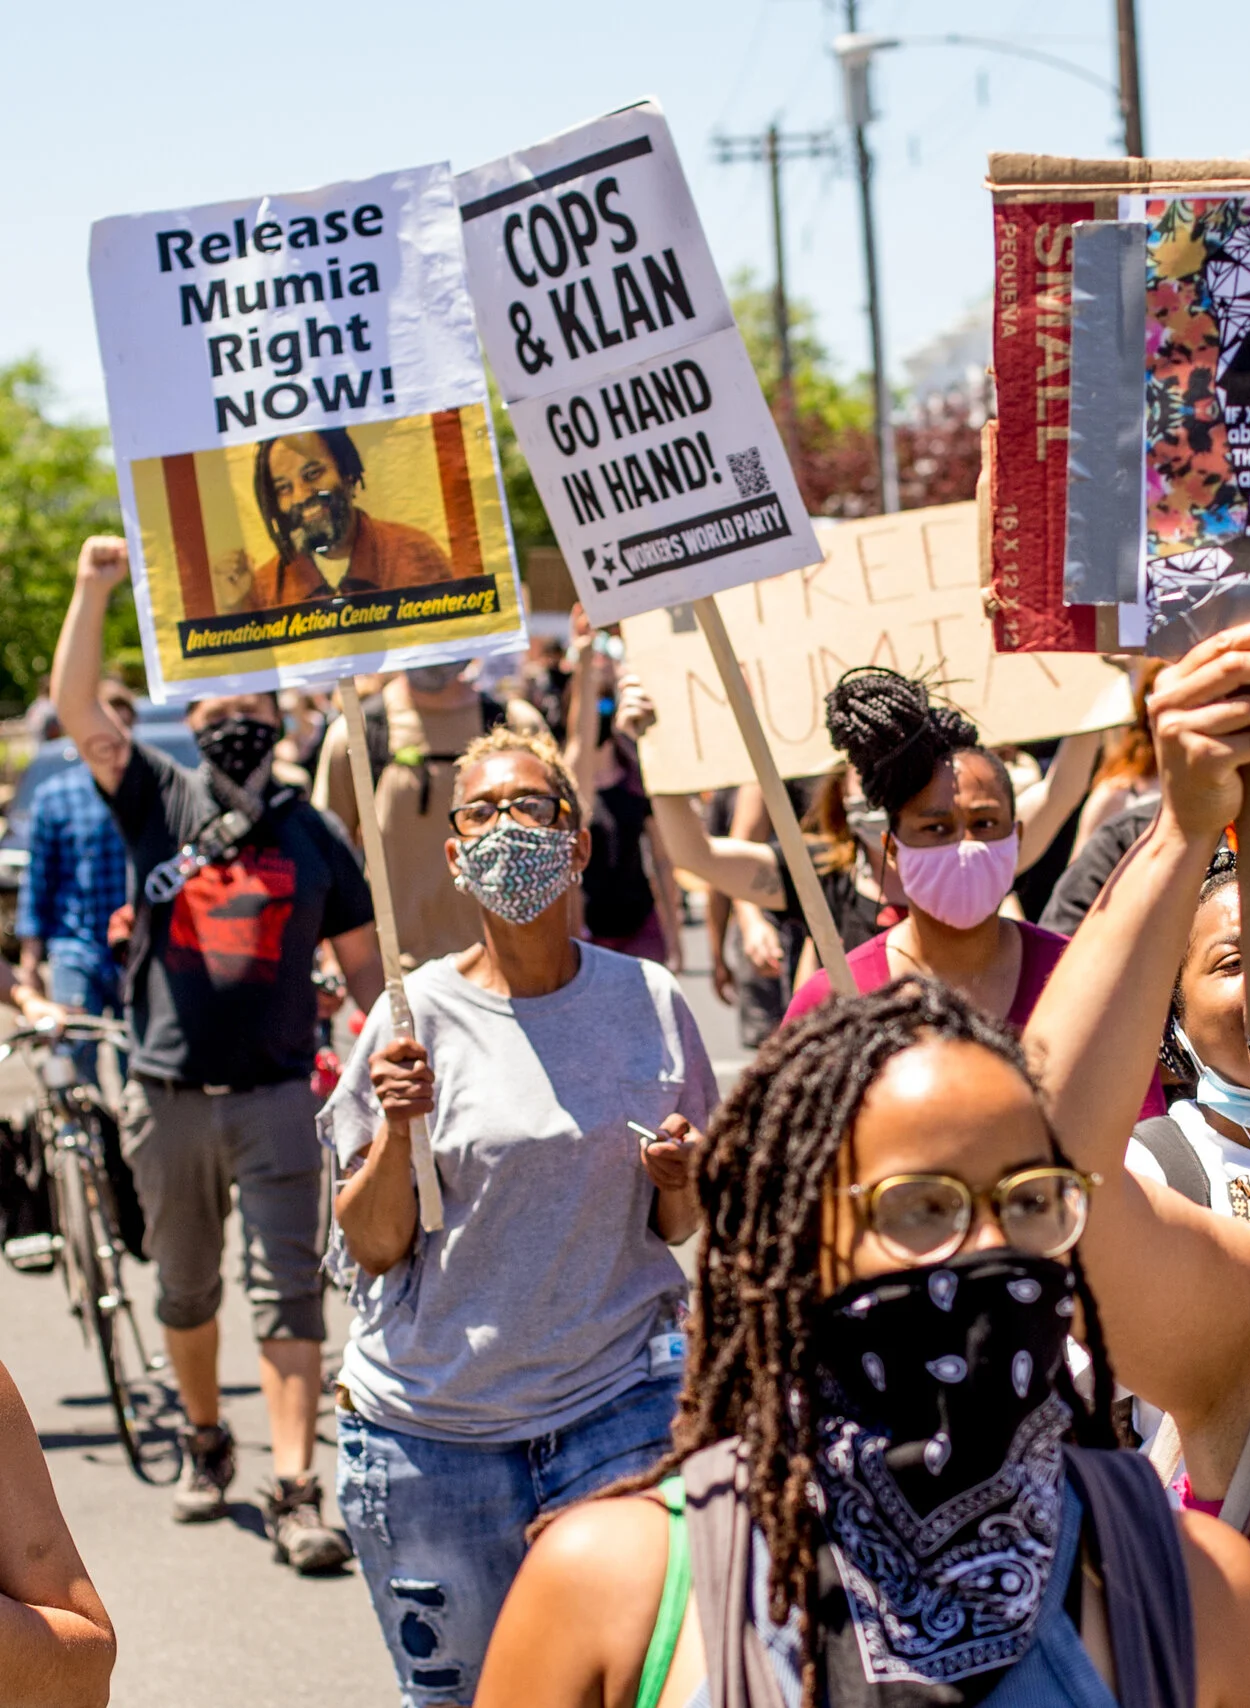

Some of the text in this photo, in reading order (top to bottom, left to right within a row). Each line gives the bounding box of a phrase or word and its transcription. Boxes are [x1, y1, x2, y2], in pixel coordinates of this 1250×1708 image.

[156, 204, 384, 273] Release
[503, 176, 638, 287] COPS
[179, 257, 381, 326] Mumia
[508, 248, 696, 375] & KLAN
[208, 314, 371, 378] Right
[1034, 222, 1072, 462] SMALL
[214, 367, 396, 433] NOW!
[546, 359, 712, 457] GO HAND
[1225, 406, 1242, 424] IF
[561, 431, 722, 526] IN HAND!
[621, 502, 785, 572] WORKERS WORLD PARTY
[1001, 504, 1019, 531] 16
[1002, 562, 1019, 588] 12
[186, 590, 496, 651] International Action Center iacenter.org
[1003, 620, 1020, 647] 12
